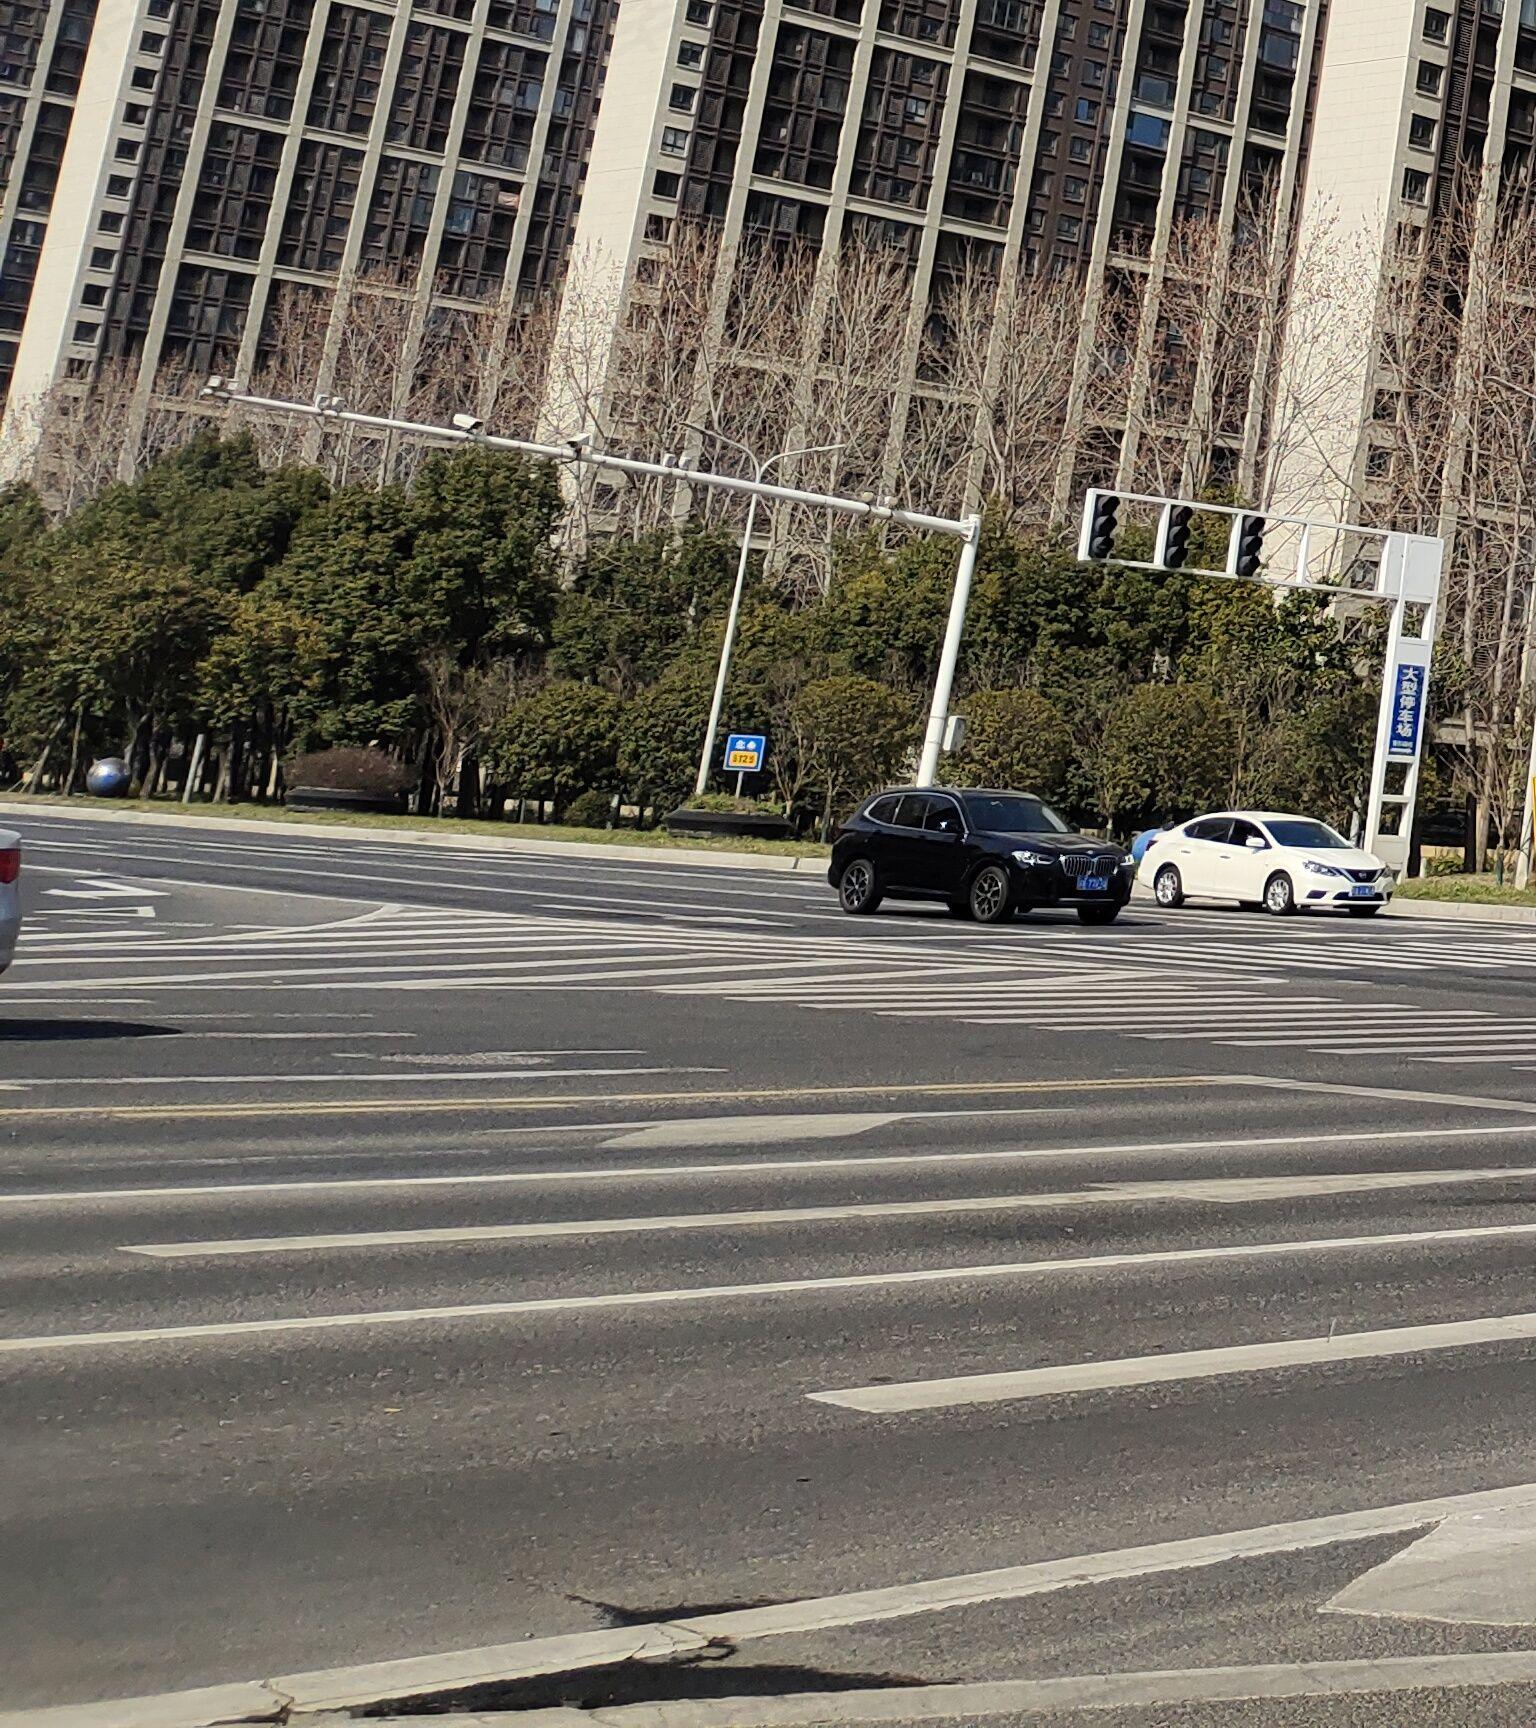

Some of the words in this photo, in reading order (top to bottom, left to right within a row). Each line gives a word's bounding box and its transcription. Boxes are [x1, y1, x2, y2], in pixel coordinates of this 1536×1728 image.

[1396, 667, 1418, 738] 大型停车场
